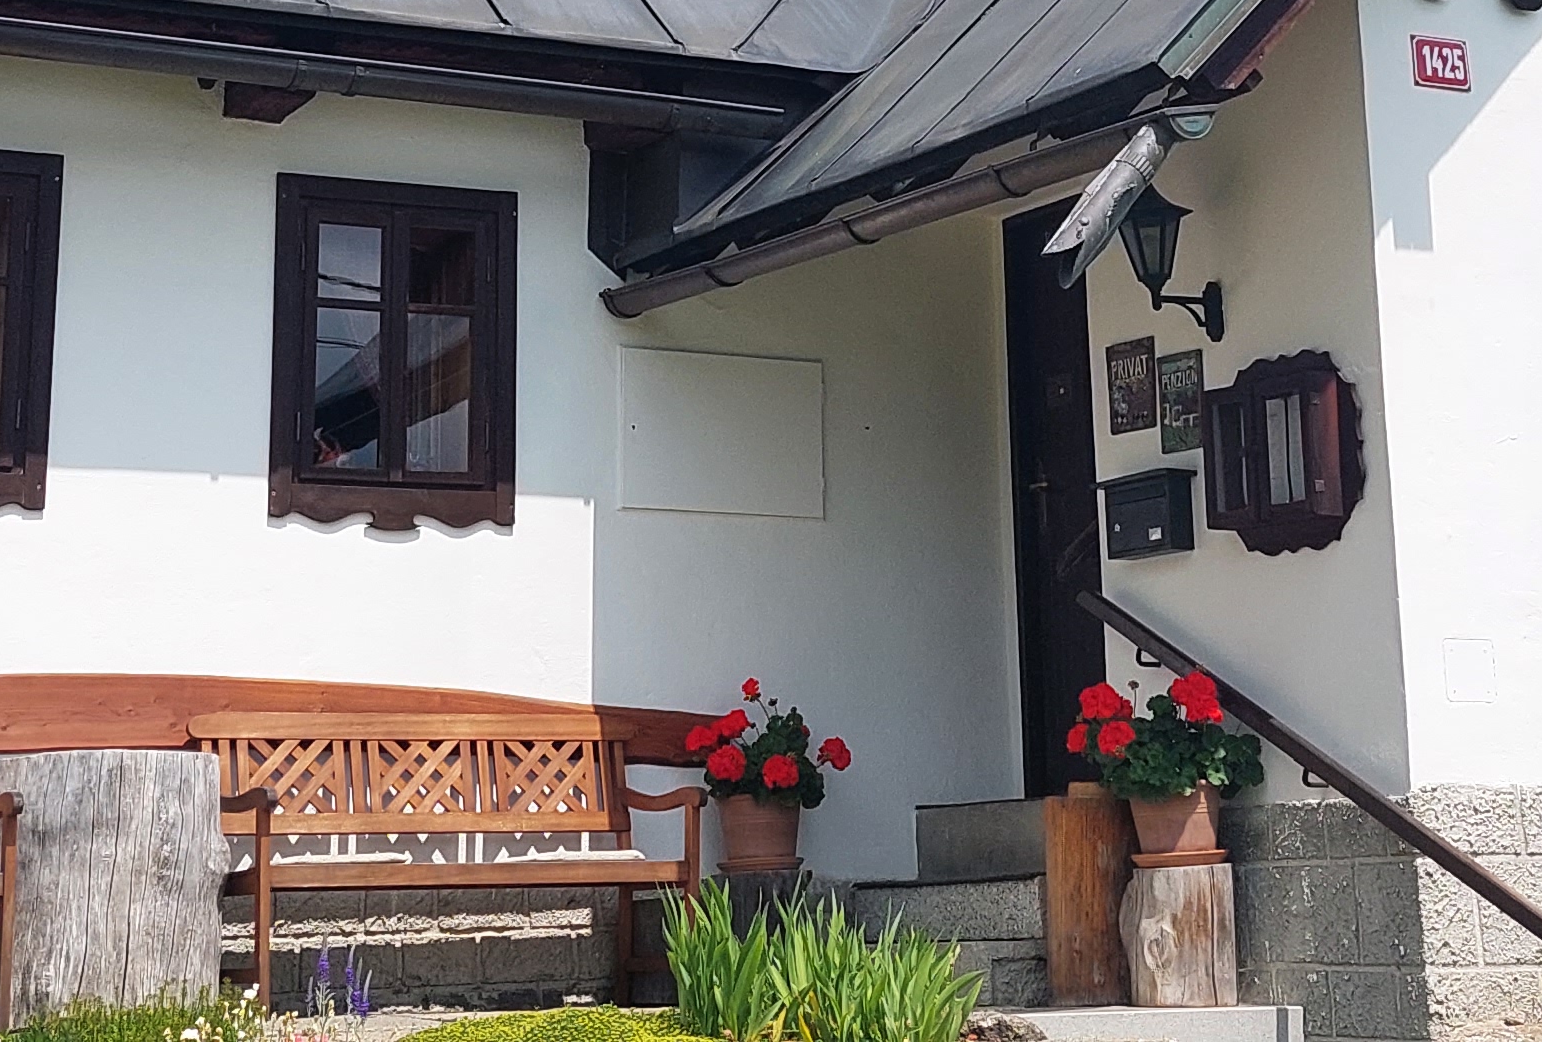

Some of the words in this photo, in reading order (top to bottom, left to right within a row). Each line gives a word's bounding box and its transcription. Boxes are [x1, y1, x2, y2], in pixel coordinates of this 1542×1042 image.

[1422, 45, 1465, 80] 1425
[1110, 354, 1148, 381] PRIVAT
[1161, 369, 1198, 391] PENZION
